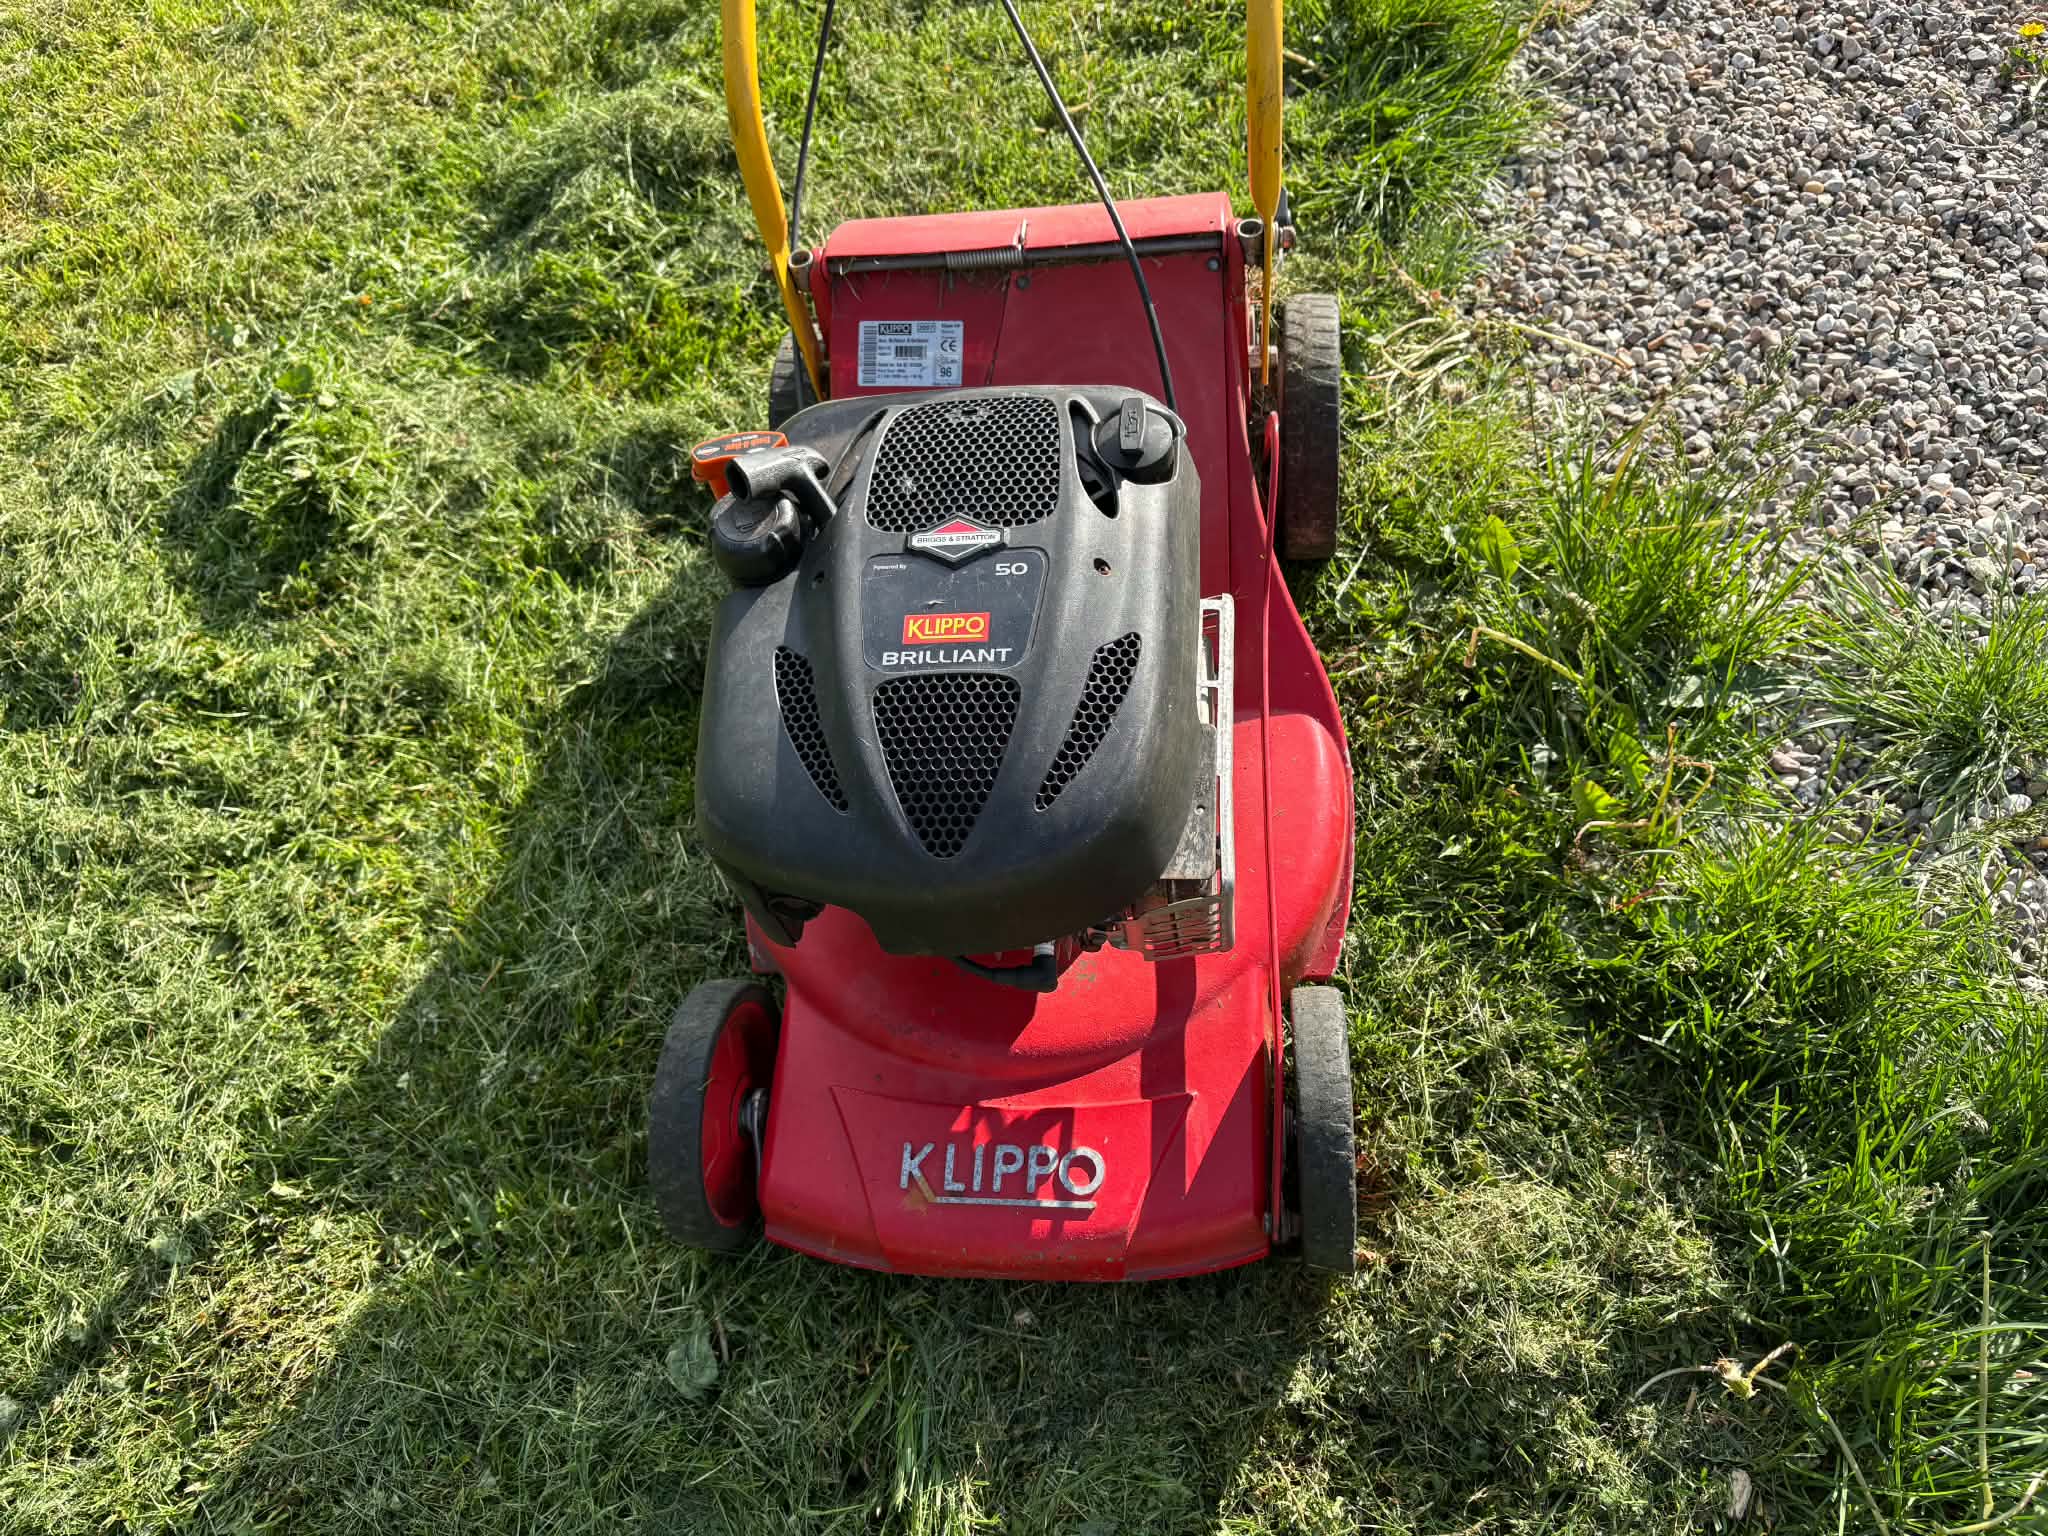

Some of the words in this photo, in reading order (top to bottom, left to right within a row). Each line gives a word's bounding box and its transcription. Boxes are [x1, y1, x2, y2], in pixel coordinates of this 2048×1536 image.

[940, 367, 952, 377] 96
[956, 534, 996, 542] STRATTON
[995, 563, 1028, 576] 50
[908, 616, 985, 639] KLIPPO
[882, 648, 1013, 665] BRILLIANT
[899, 1142, 1106, 1202] KLIPPO
